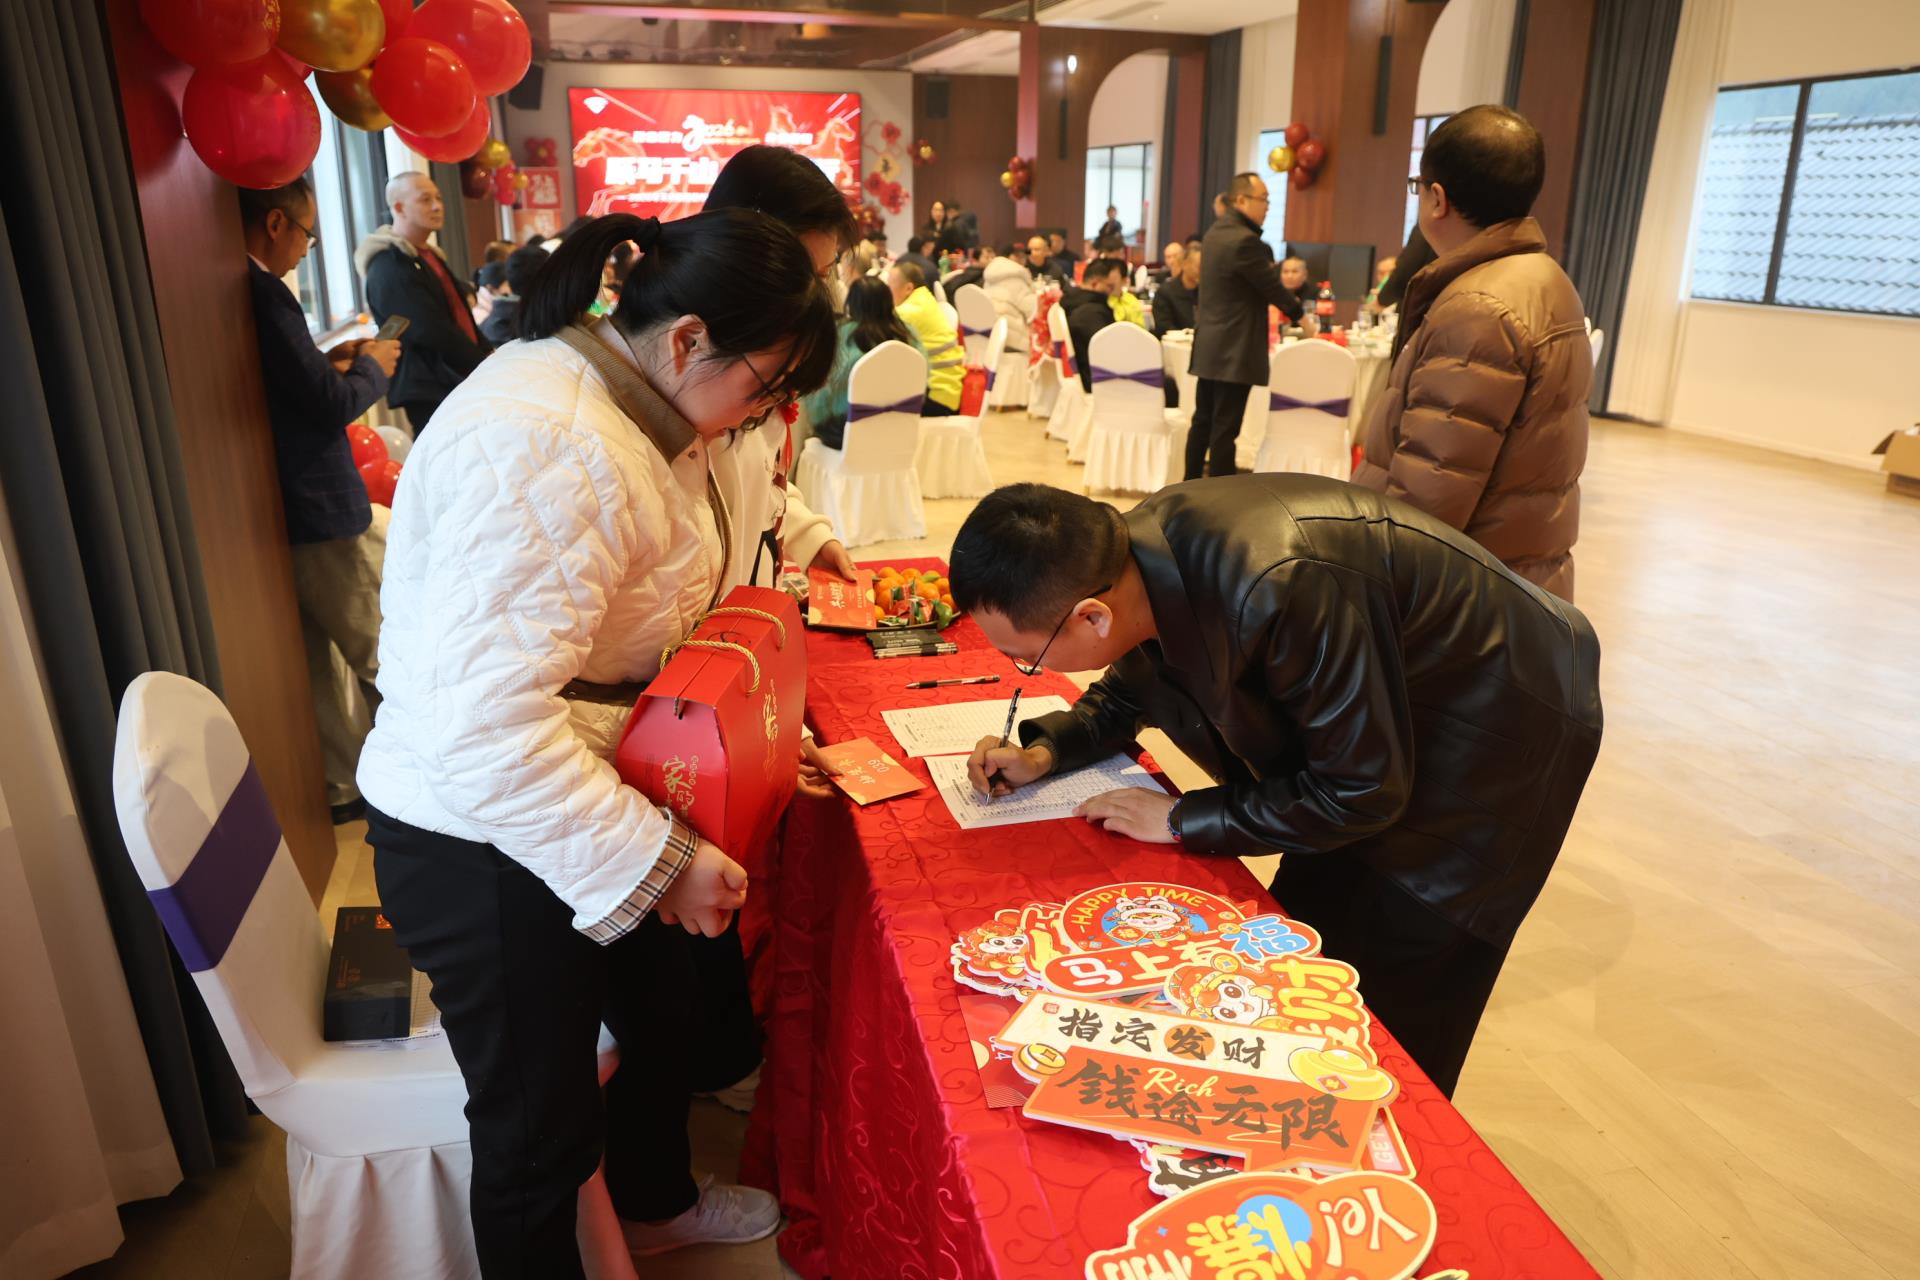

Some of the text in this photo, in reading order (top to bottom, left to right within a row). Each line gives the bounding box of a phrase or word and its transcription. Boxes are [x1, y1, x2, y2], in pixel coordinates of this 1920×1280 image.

[867, 759, 890, 773] 039
[1071, 886, 1208, 925] HAPPY TIME
[1059, 915, 1310, 987] 马上有福
[1058, 1008, 1266, 1069] 指定发财
[1144, 1067, 1219, 1098] Rich
[1320, 1188, 1418, 1267] Ye!
